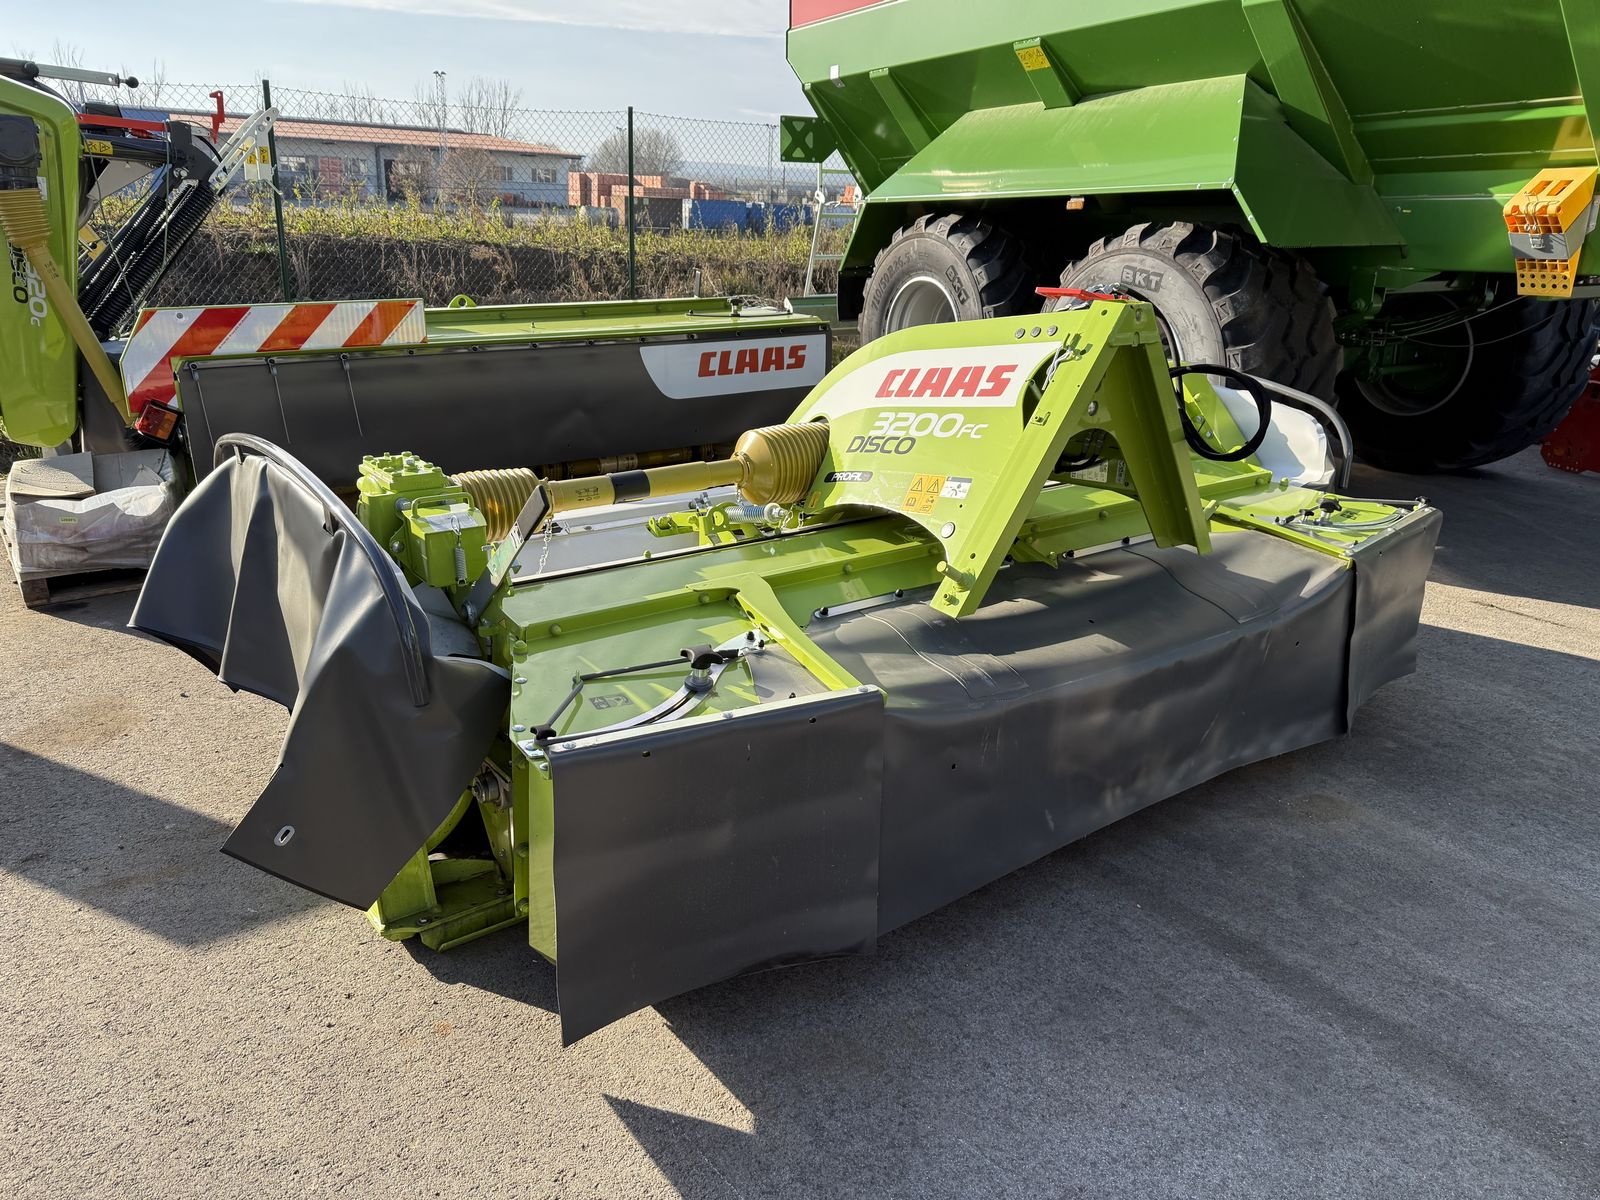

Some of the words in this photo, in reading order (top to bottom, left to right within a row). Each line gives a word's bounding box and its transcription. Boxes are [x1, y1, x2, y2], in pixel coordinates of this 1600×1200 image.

[946, 265, 970, 304] BKT
[1121, 265, 1164, 292] BKT
[698, 345, 807, 378] CLAAS
[875, 364, 1018, 398] CLAAS
[846, 436, 916, 455] DISCO
